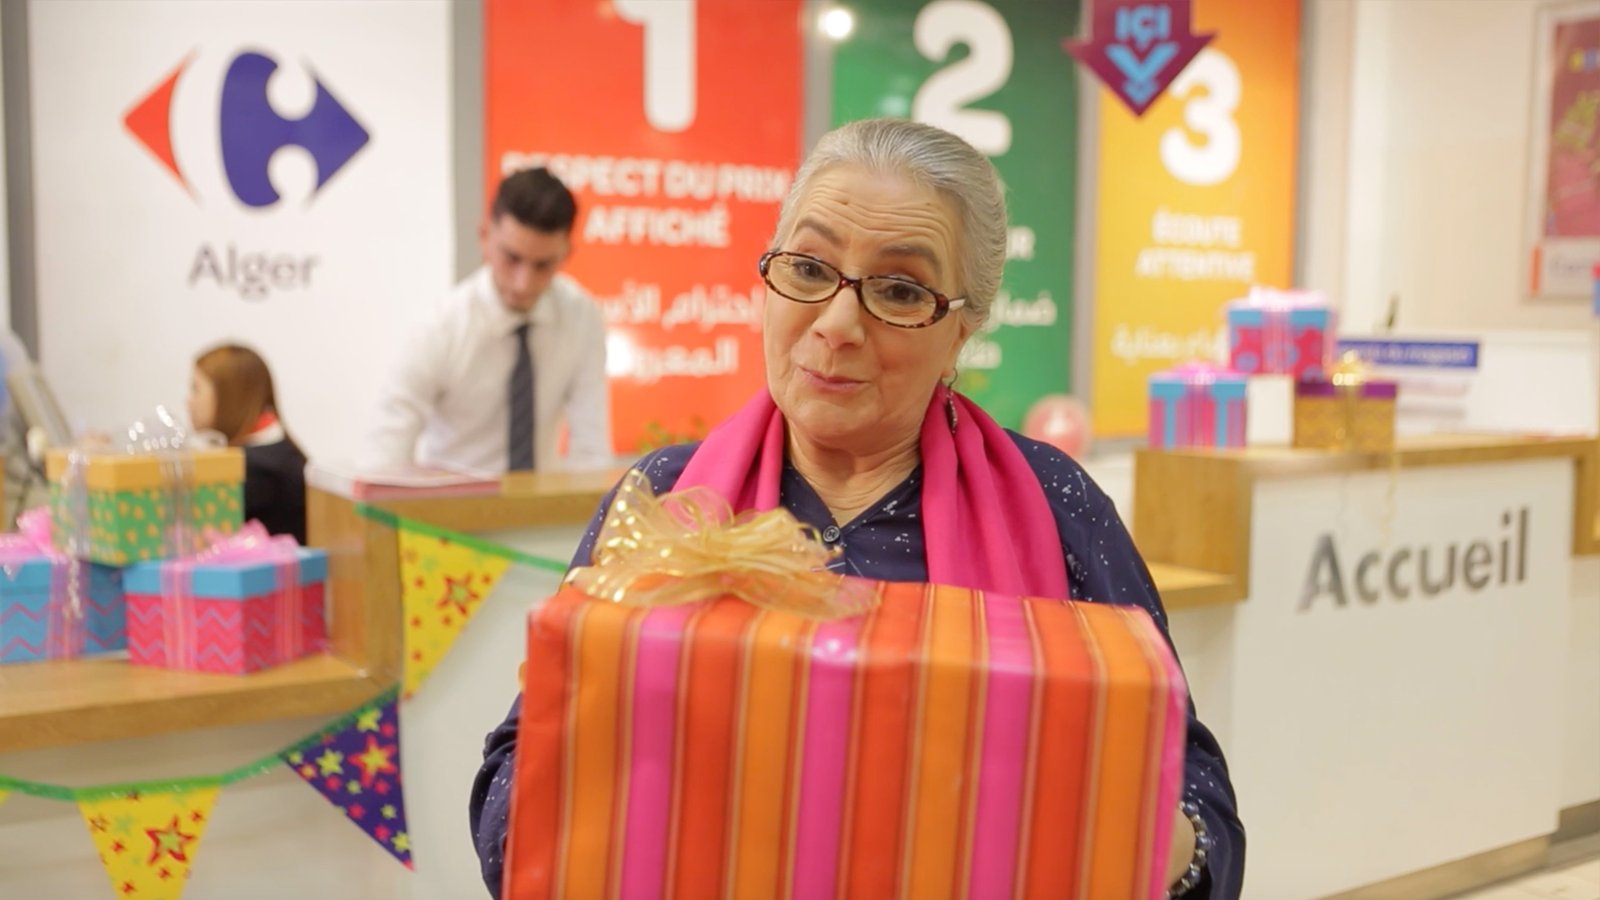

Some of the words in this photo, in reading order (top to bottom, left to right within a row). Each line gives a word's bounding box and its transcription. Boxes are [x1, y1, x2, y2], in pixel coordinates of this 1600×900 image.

[612, 0, 698, 132] 1
[1115, 5, 1171, 49] IÇI
[913, 0, 1014, 156] 2
[1158, 48, 1243, 187] 3
[663, 160, 713, 200] DU
[582, 201, 731, 247] AFFICHÉ
[188, 245, 319, 301] Alger
[1298, 507, 1530, 613] Accueil
